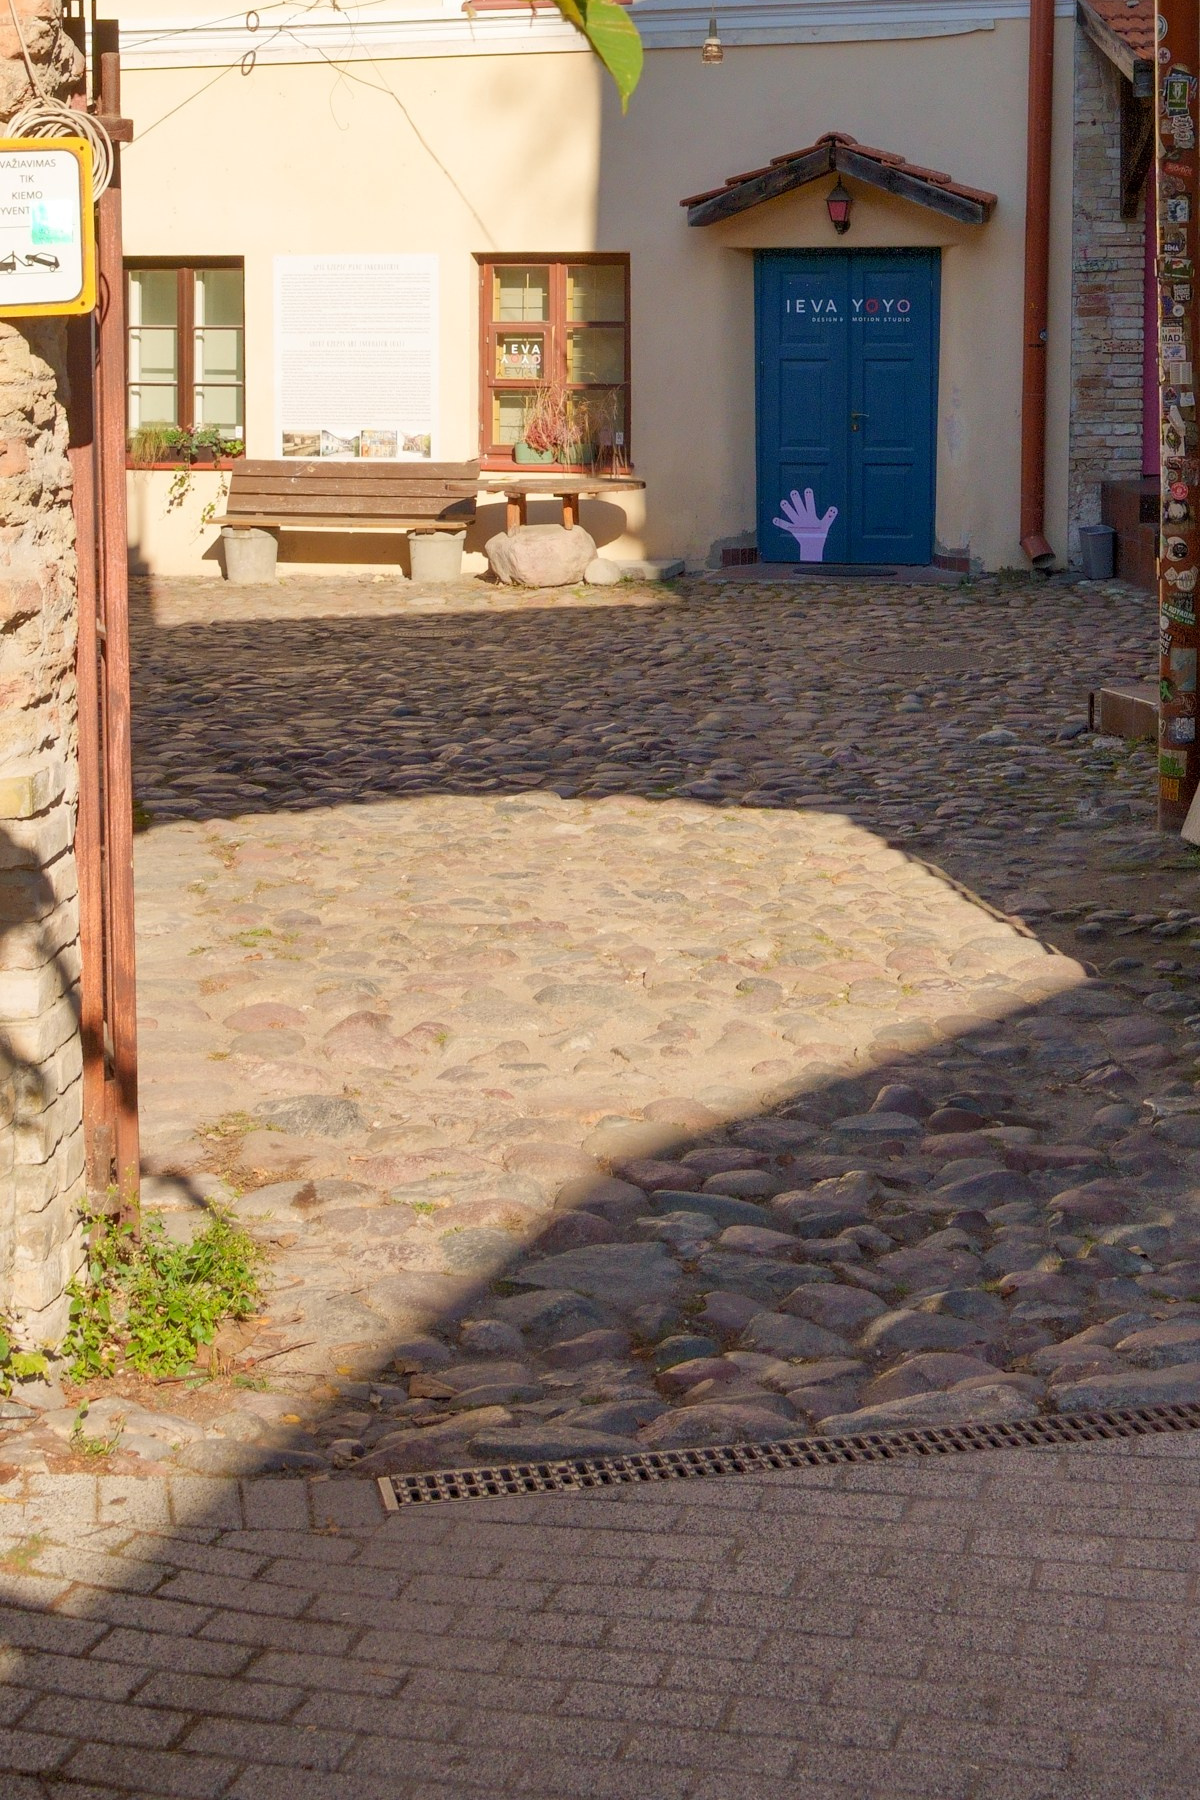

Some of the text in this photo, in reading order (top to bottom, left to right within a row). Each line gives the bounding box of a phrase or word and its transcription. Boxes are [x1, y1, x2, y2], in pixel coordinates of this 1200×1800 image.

[20, 174, 34, 183] TIK
[11, 191, 43, 200] KIEMO
[786, 299, 911, 313] IEVA YOYO
[502, 344, 541, 354] IEVA
